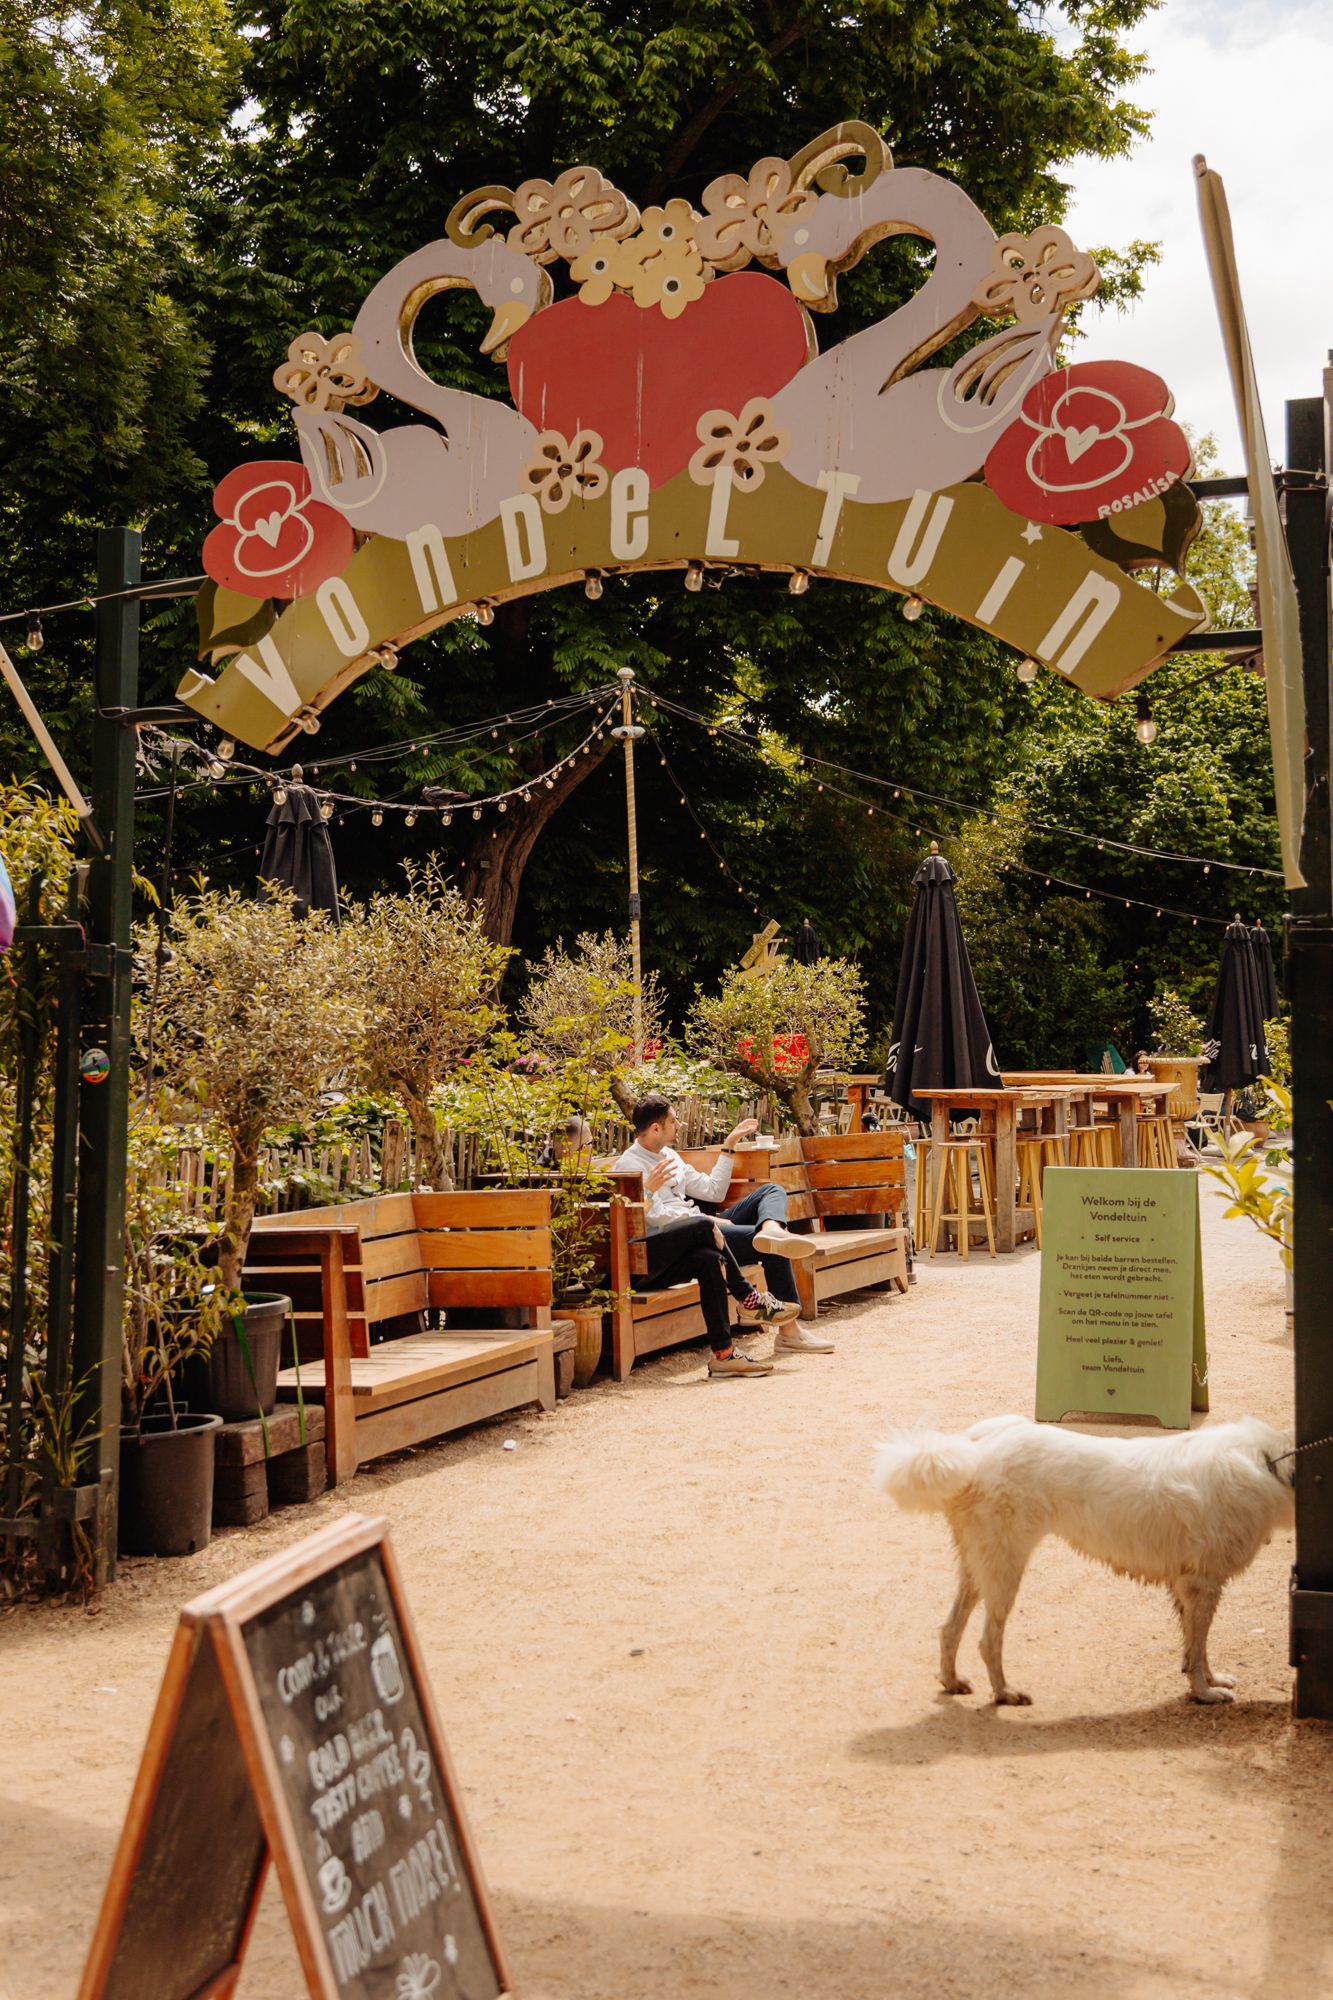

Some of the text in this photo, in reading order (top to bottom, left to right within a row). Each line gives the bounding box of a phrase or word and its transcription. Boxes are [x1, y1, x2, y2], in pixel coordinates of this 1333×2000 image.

[1081, 1196, 1156, 1209] Welkom bij de
[1090, 1211, 1147, 1222] Vondeltuin
[1095, 1234, 1140, 1243] Self service
[1065, 1254, 1079, 1262] kan
[1081, 1254, 1090, 1263] bij
[1062, 1262, 1096, 1272] Drankjes
[1120, 1265, 1127, 1273] je
[1070, 1271, 1083, 1279] het
[1102, 1273, 1125, 1281] wordt
[1127, 1275, 1163, 1283] gebracht.
[1064, 1290, 1169, 1301] Vergeet je tafelnummer niet
[1077, 1308, 1087, 1316] de
[1089, 1308, 1122, 1318] QR-code
[1135, 1311, 1154, 1320] jouw
[1156, 1312, 1173, 1320] tafel
[1085, 1317, 1098, 1326] het
[1100, 1319, 1121, 1327] menu
[1122, 1319, 1130, 1327] in
[1141, 1320, 1159, 1328] zien.
[1066, 1336, 1164, 1348] Heel veel plezier & geniet!
[1103, 1364, 1145, 1374] Vondeltuin
[389, 1818, 462, 1925] MORE!
